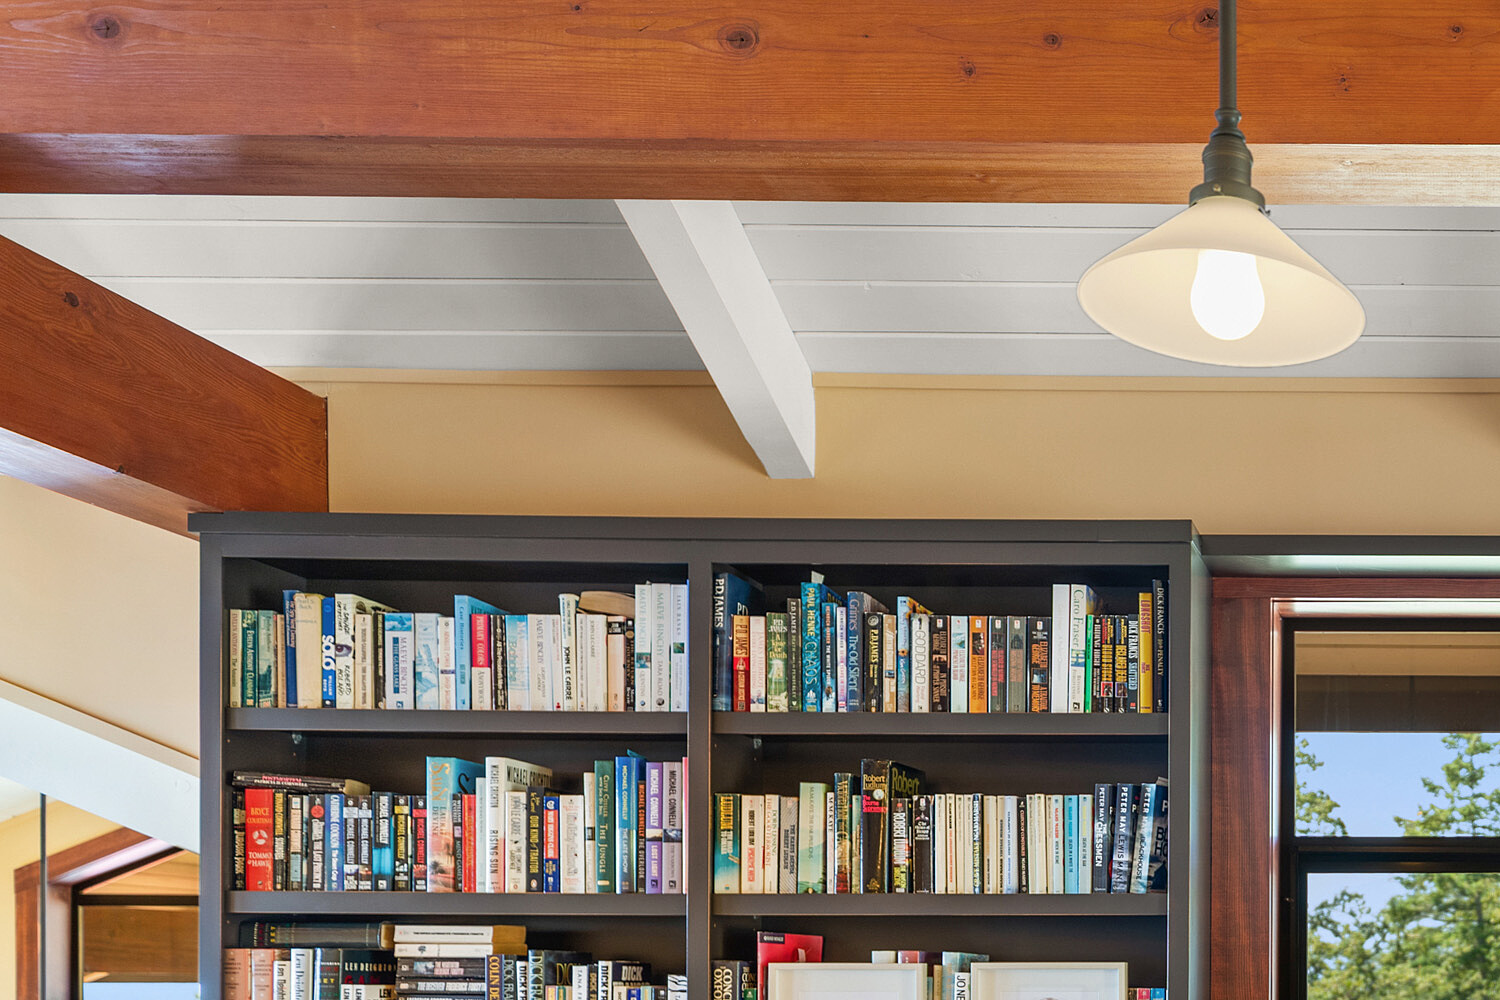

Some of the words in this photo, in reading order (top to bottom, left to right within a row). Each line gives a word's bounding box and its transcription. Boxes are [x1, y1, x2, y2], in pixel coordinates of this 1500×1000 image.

[1073, 590, 1083, 614] Caro
[850, 599, 859, 630] Grimes
[1141, 600, 1150, 633] LONGSHOT
[1073, 617, 1083, 647] Fraser
[1128, 621, 1138, 634] DICK
[849, 635, 858, 649] The
[1128, 635, 1138, 658] FRANCIS
[805, 642, 817, 685] CHAOS
[849, 650, 858, 665] Old
[915, 630, 925, 684] GODDARD
[849, 667, 858, 691] Silent
[1128, 662, 1137, 690] SHATTERED
[894, 813, 905, 837] ROBERT
[490, 830, 498, 856] RISING
[894, 839, 905, 864] LUDLUM
[1117, 834, 1125, 858] LEWIS
[490, 859, 498, 874] SUN
[598, 844, 608, 872] JUNGLE
[490, 956, 499, 985] COLIN
[504, 960, 514, 980] DICK
[600, 965, 608, 988] DICK
